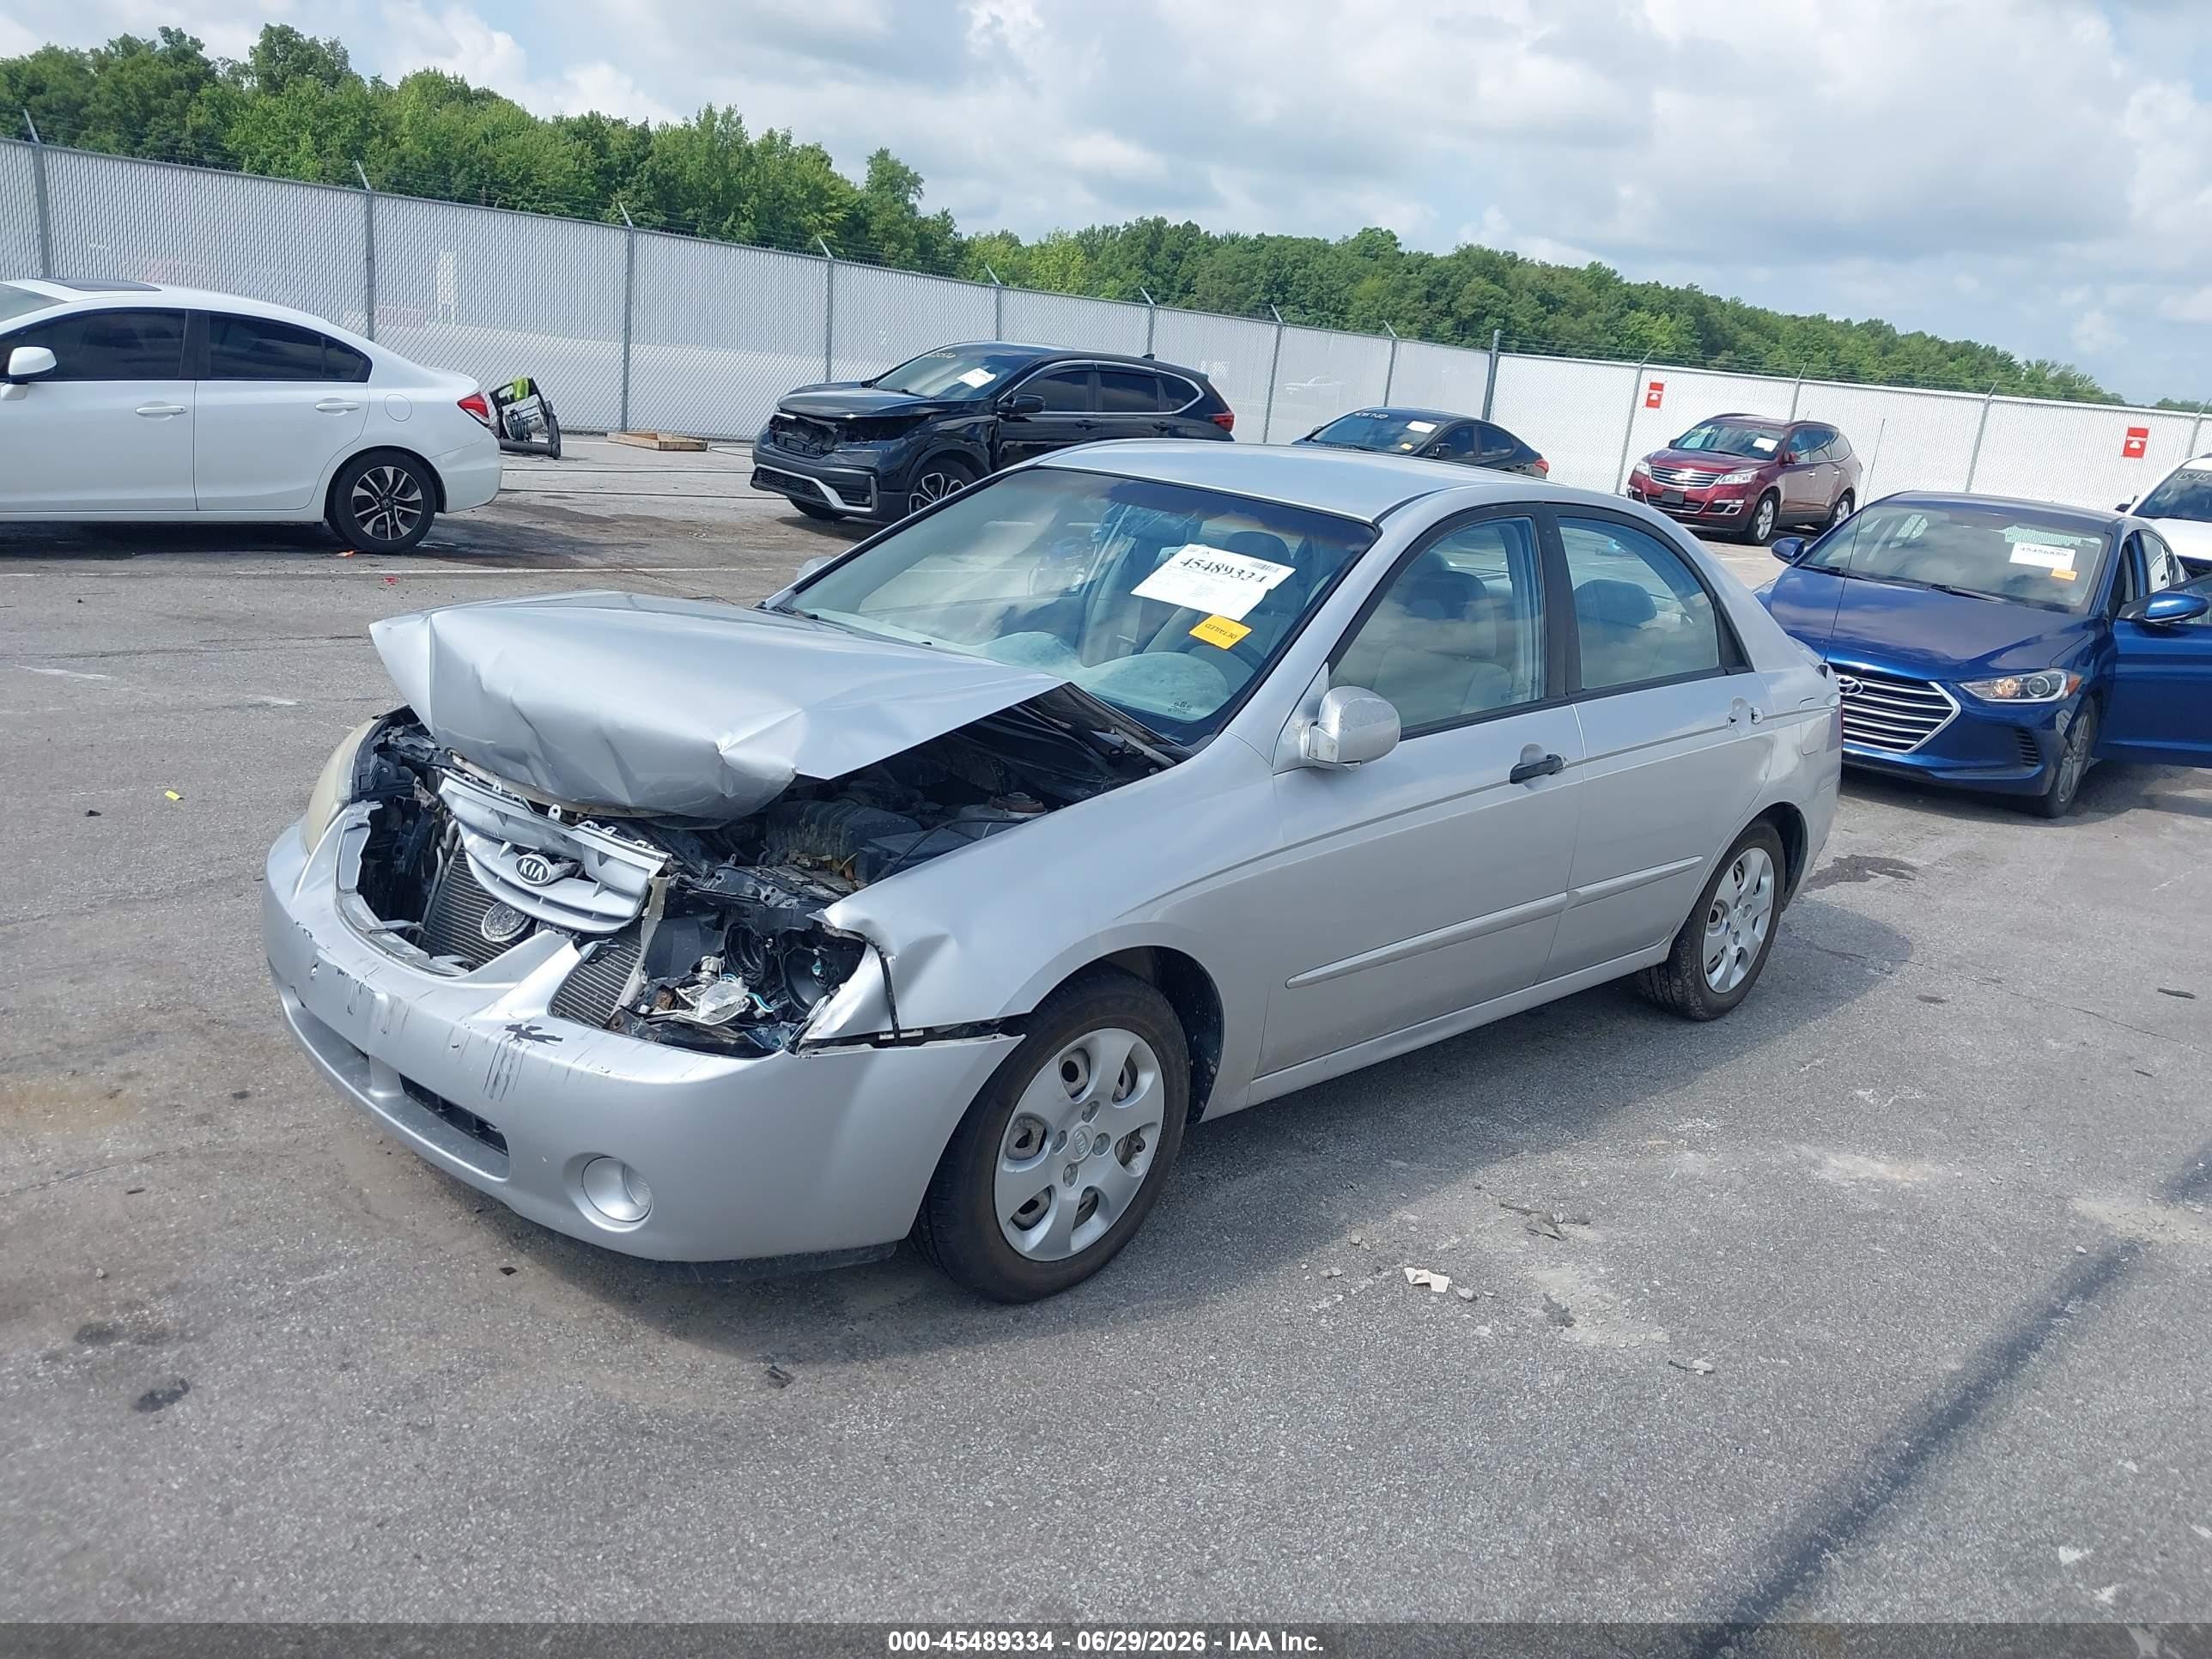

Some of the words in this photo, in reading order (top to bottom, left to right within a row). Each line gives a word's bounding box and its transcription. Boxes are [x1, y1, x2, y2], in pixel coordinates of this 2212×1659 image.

[1179, 557, 1268, 584] 45489334
[1205, 623, 1237, 640] DETAILED
[520, 859, 544, 881] KIA
